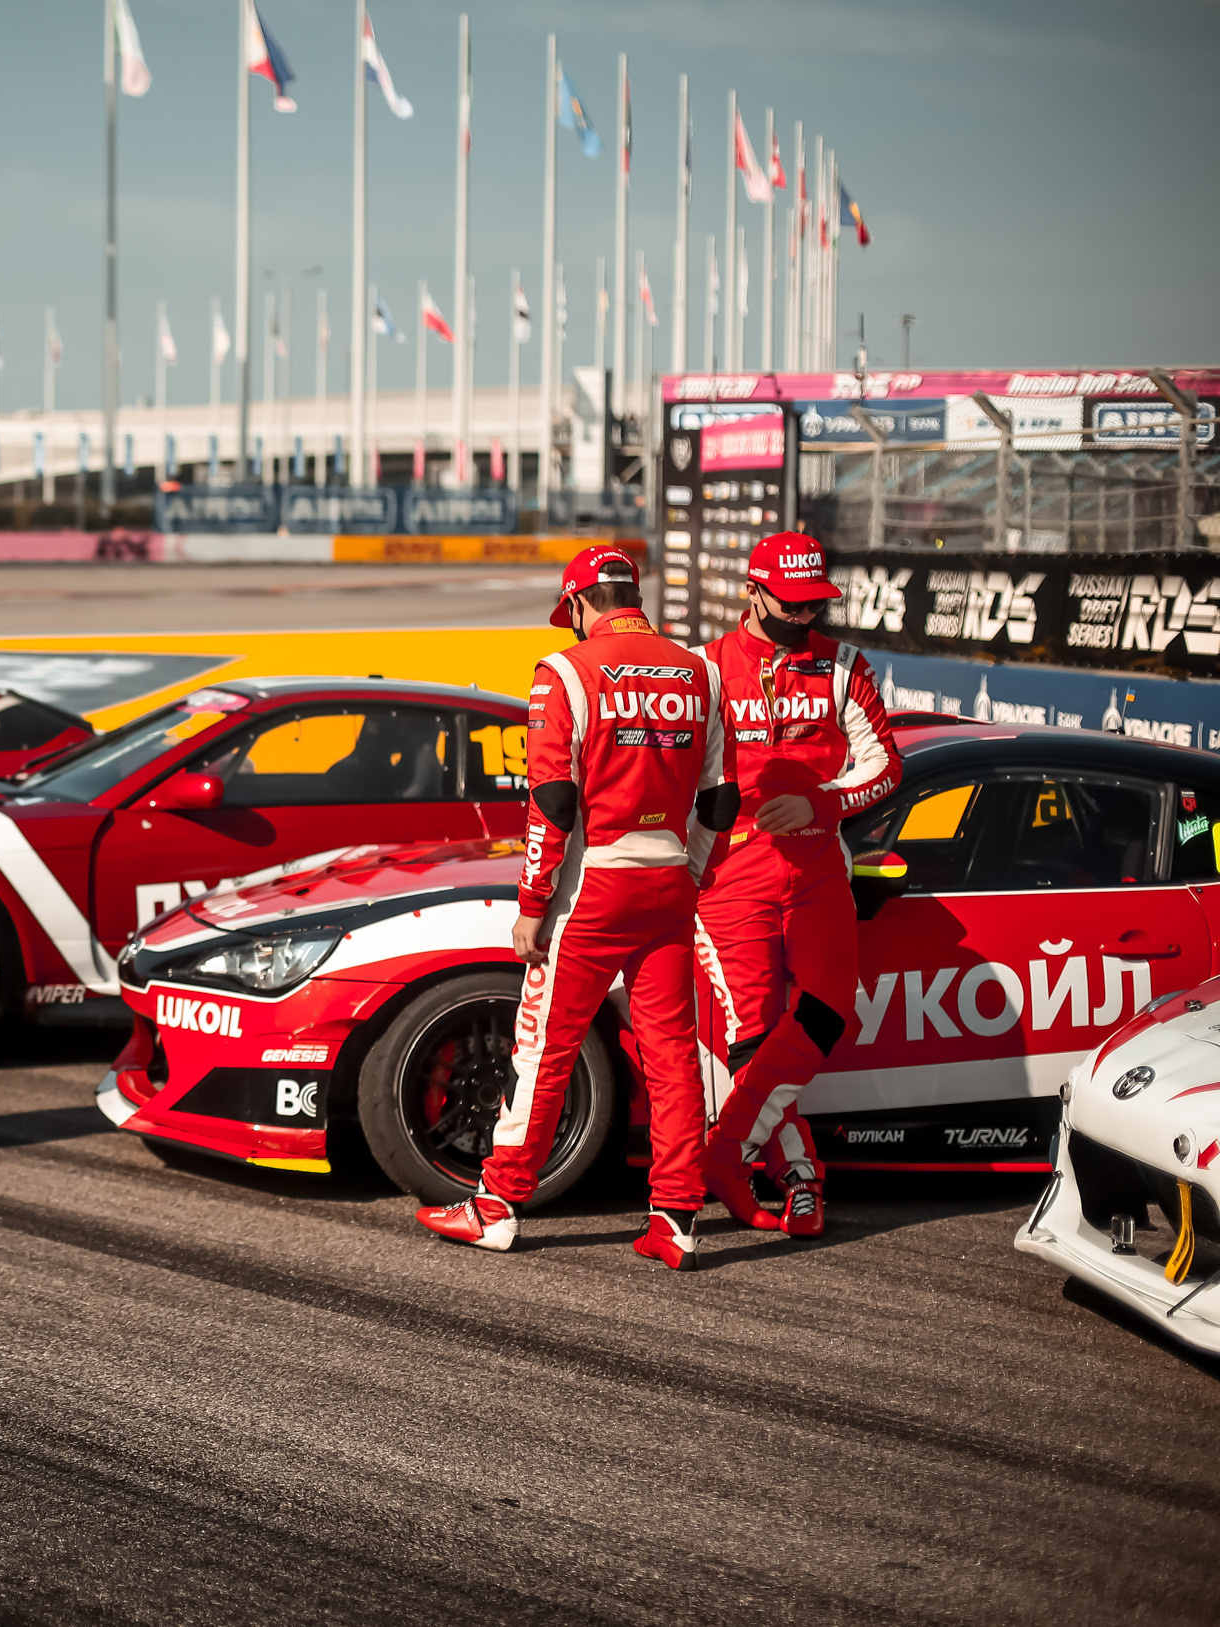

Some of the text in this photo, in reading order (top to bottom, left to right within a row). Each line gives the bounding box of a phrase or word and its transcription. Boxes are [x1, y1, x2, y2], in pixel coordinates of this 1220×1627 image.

[1068, 573, 1126, 598] RUSSIAN
[1079, 598, 1121, 623] DRIFT
[1067, 621, 1115, 648] SERIES
[599, 664, 694, 684] VIPER
[598, 691, 706, 723] LUKOIL
[729, 691, 830, 722] УКОЙЛ
[855, 937, 1153, 1046] УКОЙЛ
[156, 994, 243, 1038] LUKOIL
[261, 1045, 329, 1062] GENESIS
[847, 1129, 905, 1143] ВУЛКАН
